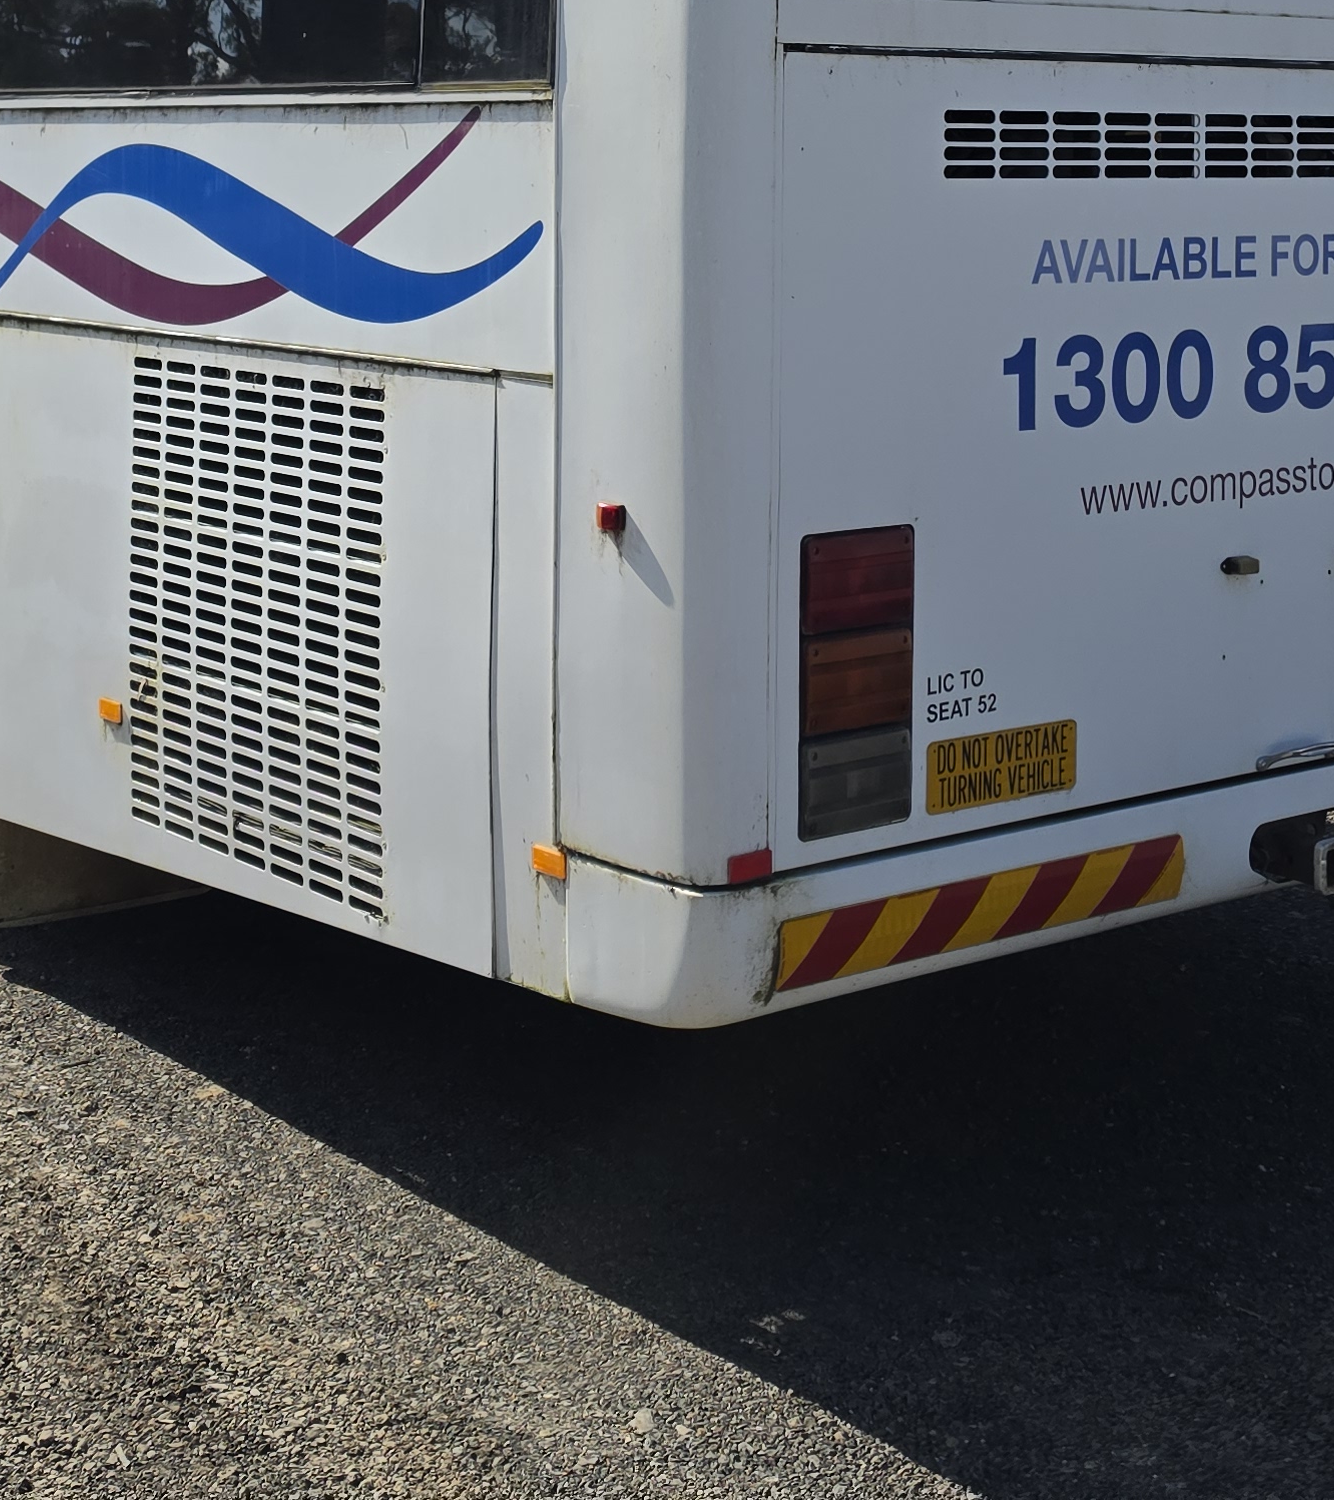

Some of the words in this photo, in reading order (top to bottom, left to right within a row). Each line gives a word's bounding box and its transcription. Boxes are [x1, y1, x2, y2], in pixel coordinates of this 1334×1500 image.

[1031, 235, 1258, 285] AVAILABLE
[1003, 328, 1214, 432] 1300
[927, 672, 955, 696] LIC
[960, 668, 984, 689] TO
[926, 697, 973, 723] SEAT
[977, 693, 997, 714] 52
[937, 742, 957, 776] DO
[961, 736, 990, 771] NOT
[995, 723, 1069, 765] OVERTAKE
[939, 768, 1002, 808] TURNING
[1008, 756, 1067, 795] VEHICLE
